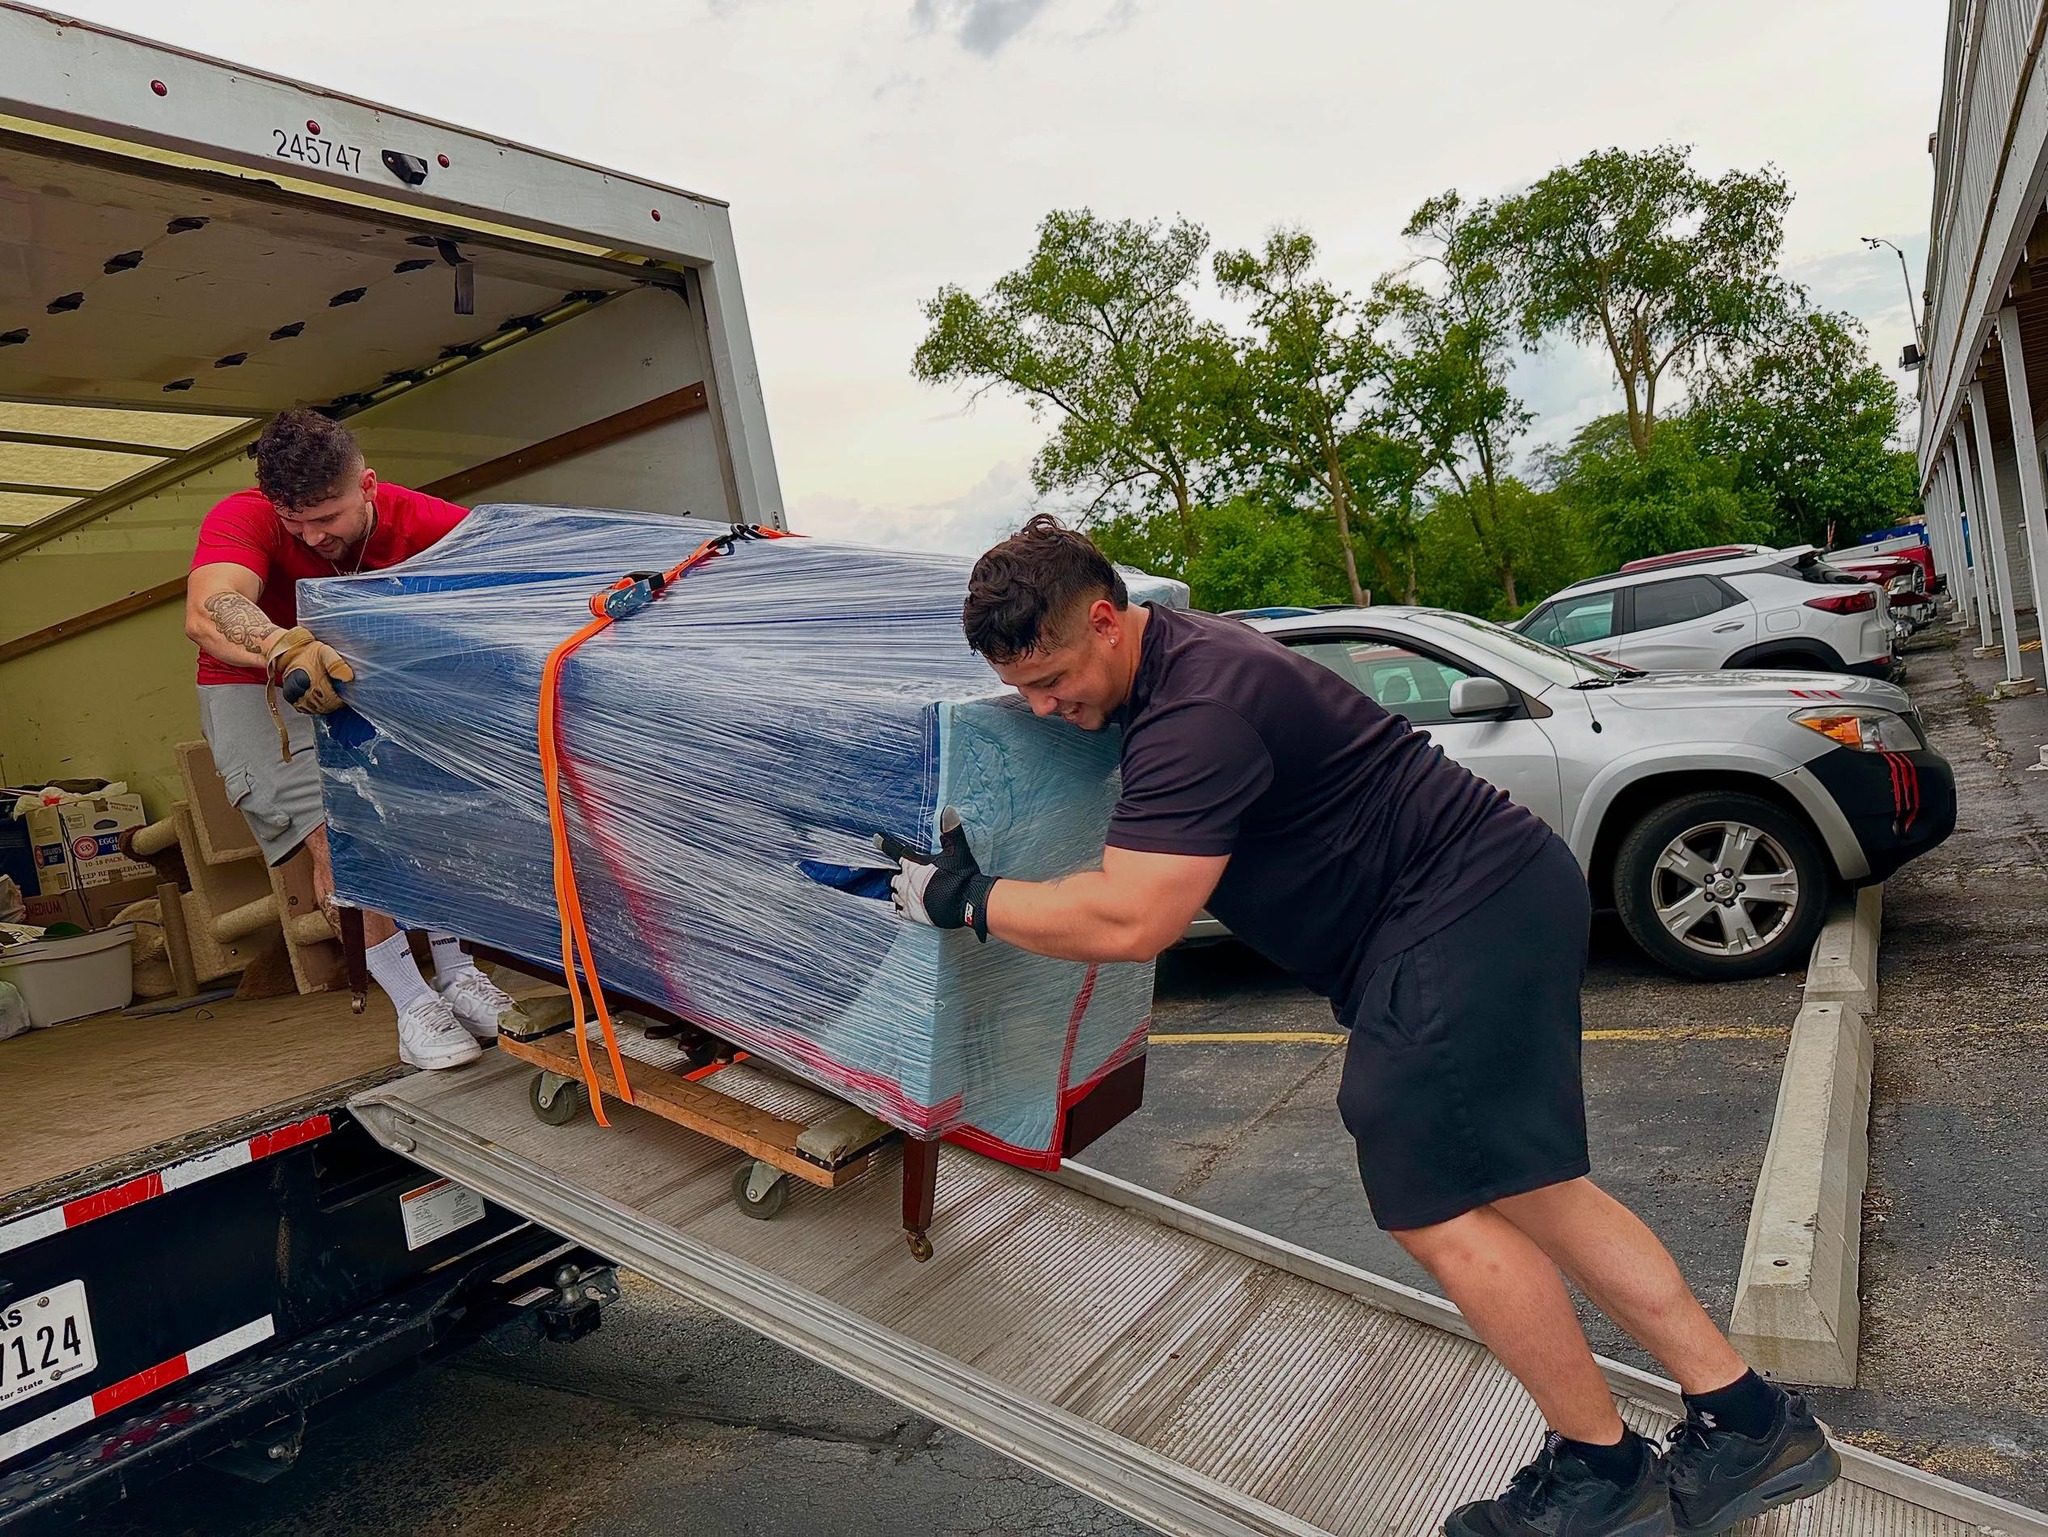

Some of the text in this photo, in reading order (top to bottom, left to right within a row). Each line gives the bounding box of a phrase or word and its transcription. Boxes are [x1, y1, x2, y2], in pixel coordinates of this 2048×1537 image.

[273, 129, 361, 173] 245747
[105, 856, 123, 864] PACK
[26, 900, 62, 917] MEDIUM
[17, 1379, 44, 1394] State
